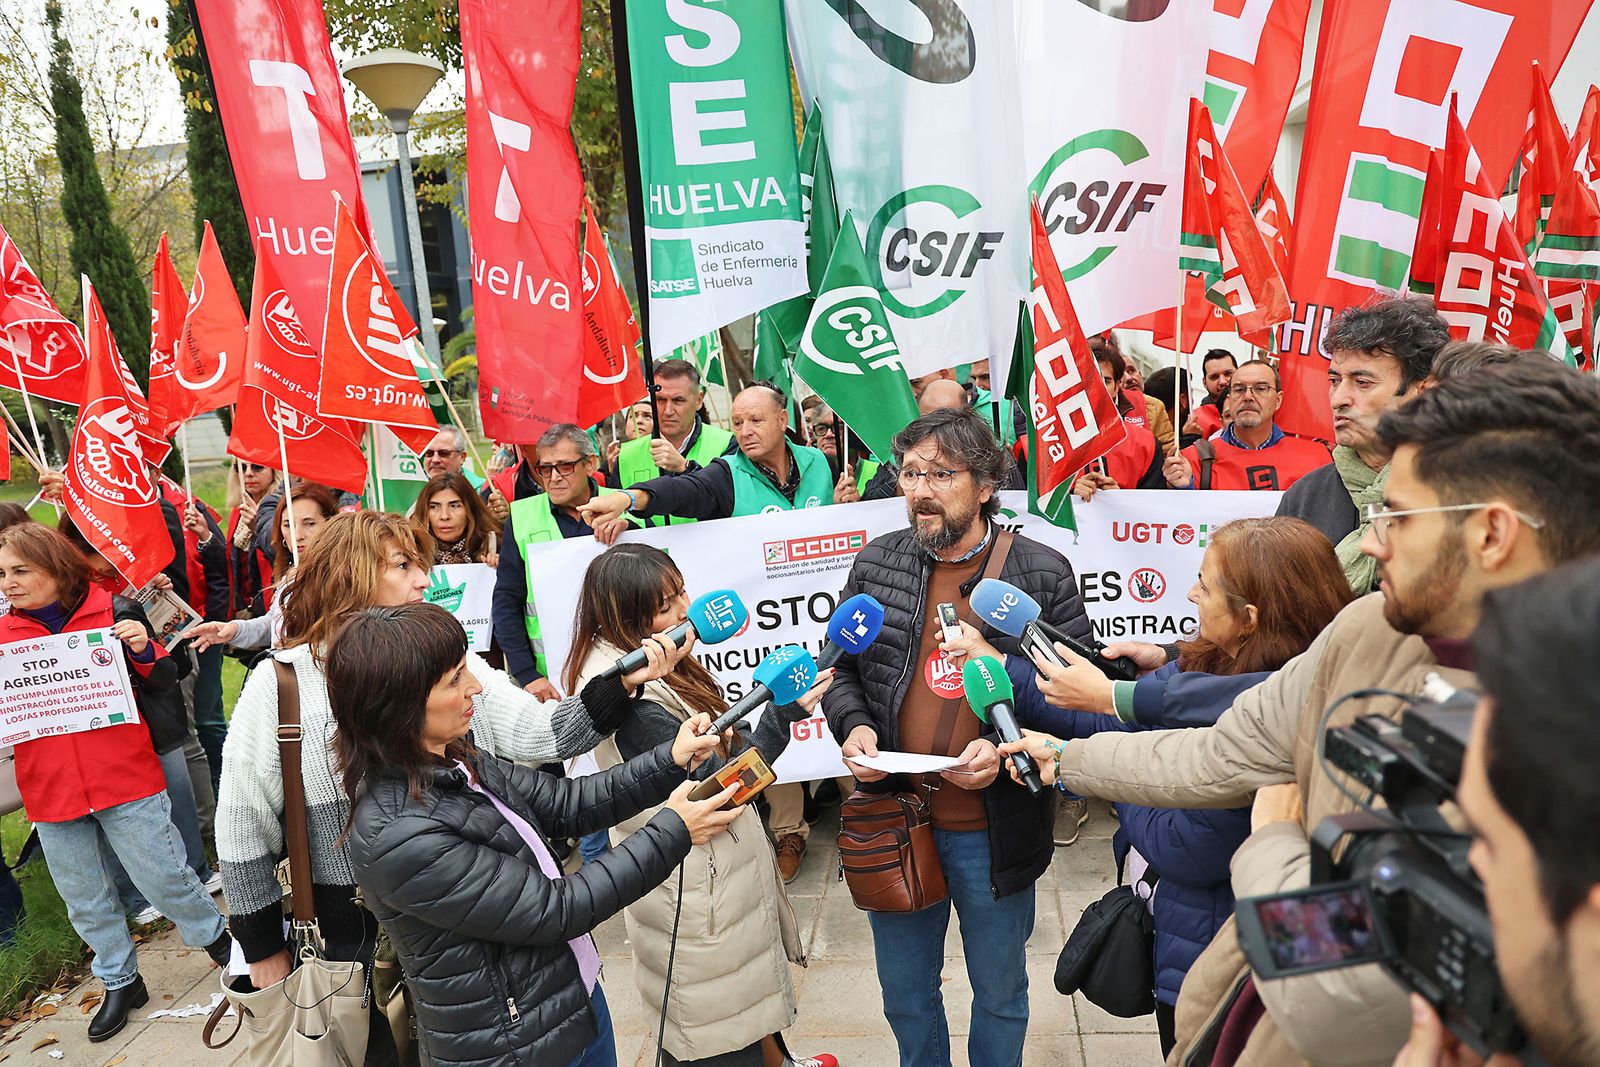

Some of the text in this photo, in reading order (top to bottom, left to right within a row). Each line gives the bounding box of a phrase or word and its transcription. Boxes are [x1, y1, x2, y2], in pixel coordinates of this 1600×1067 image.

[649, 176, 787, 216] HUELVA
[1042, 180, 1168, 235] CSIF
[698, 239, 764, 256] Sindicato
[886, 228, 1005, 279] CSIF
[470, 237, 571, 312] uelva
[701, 255, 798, 273] de Enfermería
[650, 277, 697, 293] SATSE
[704, 275, 753, 289] Huelva
[827, 306, 903, 372] CSIF
[345, 384, 431, 409] w.ugt.es
[1112, 521, 1168, 544] UGT
[791, 536, 848, 557] CCOO
[765, 563, 800, 572] federación
[801, 560, 810, 568] de
[811, 557, 835, 566] sanidad
[766, 569, 815, 580] sociosanitarios
[816, 566, 825, 574] de
[756, 590, 844, 630] STO
[990, 592, 1019, 621] tve
[11, 645, 31, 655] UGT
[22, 658, 58, 672] STOP
[3, 668, 91, 690] AGRESIONES
[6, 683, 89, 703] INCUMPLIMIENTOS
[90, 682, 101, 690] DE
[103, 680, 115, 688] LA
[62, 695, 79, 704] LOS
[80, 689, 124, 702] SUFRIMOS
[5, 701, 108, 725] LOS/AS PROFESIONALES
[37, 726, 55, 735] UGT
